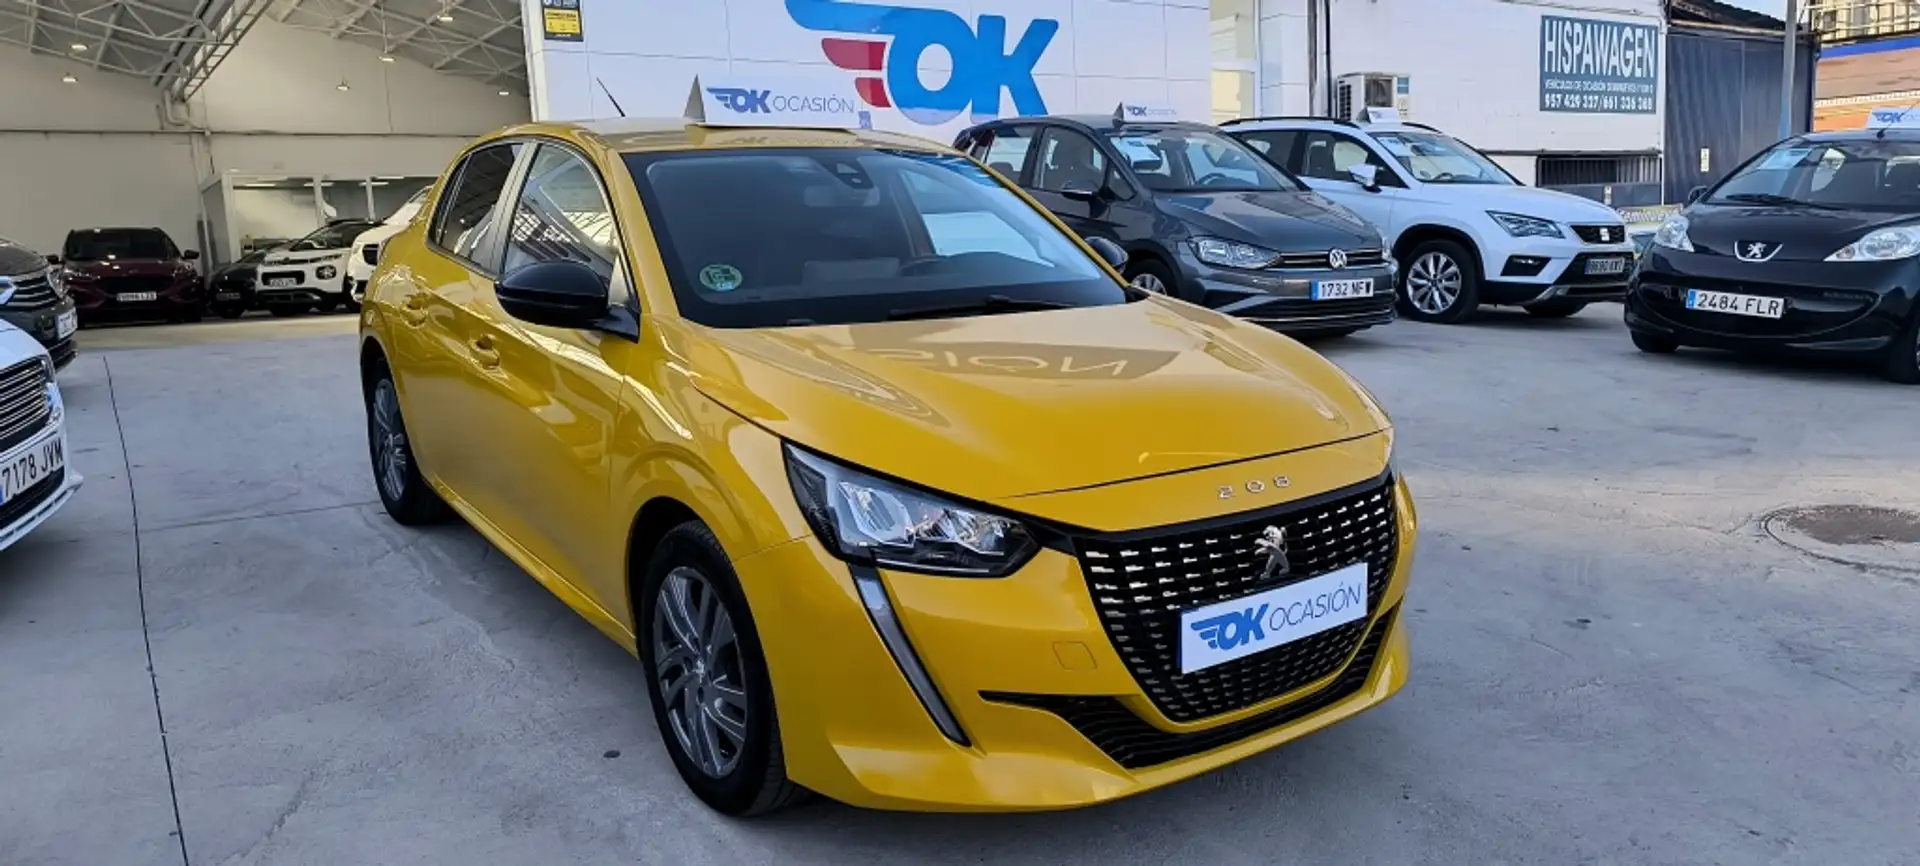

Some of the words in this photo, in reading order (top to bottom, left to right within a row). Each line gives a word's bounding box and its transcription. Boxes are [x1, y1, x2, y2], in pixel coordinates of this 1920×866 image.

[1544, 19, 1655, 78] HISPAWAGEN
[886, 8, 1059, 126] OK
[728, 89, 772, 113] OK
[772, 94, 854, 113] OCASIÓN
[1321, 283, 1348, 297] 1732
[1697, 294, 1739, 310] 2484
[1745, 298, 1780, 315] FLR
[2, 453, 37, 498] 7178
[1218, 474, 1290, 499] 208
[1216, 603, 1270, 651] OK
[1269, 581, 1362, 632] OCASIÓN
